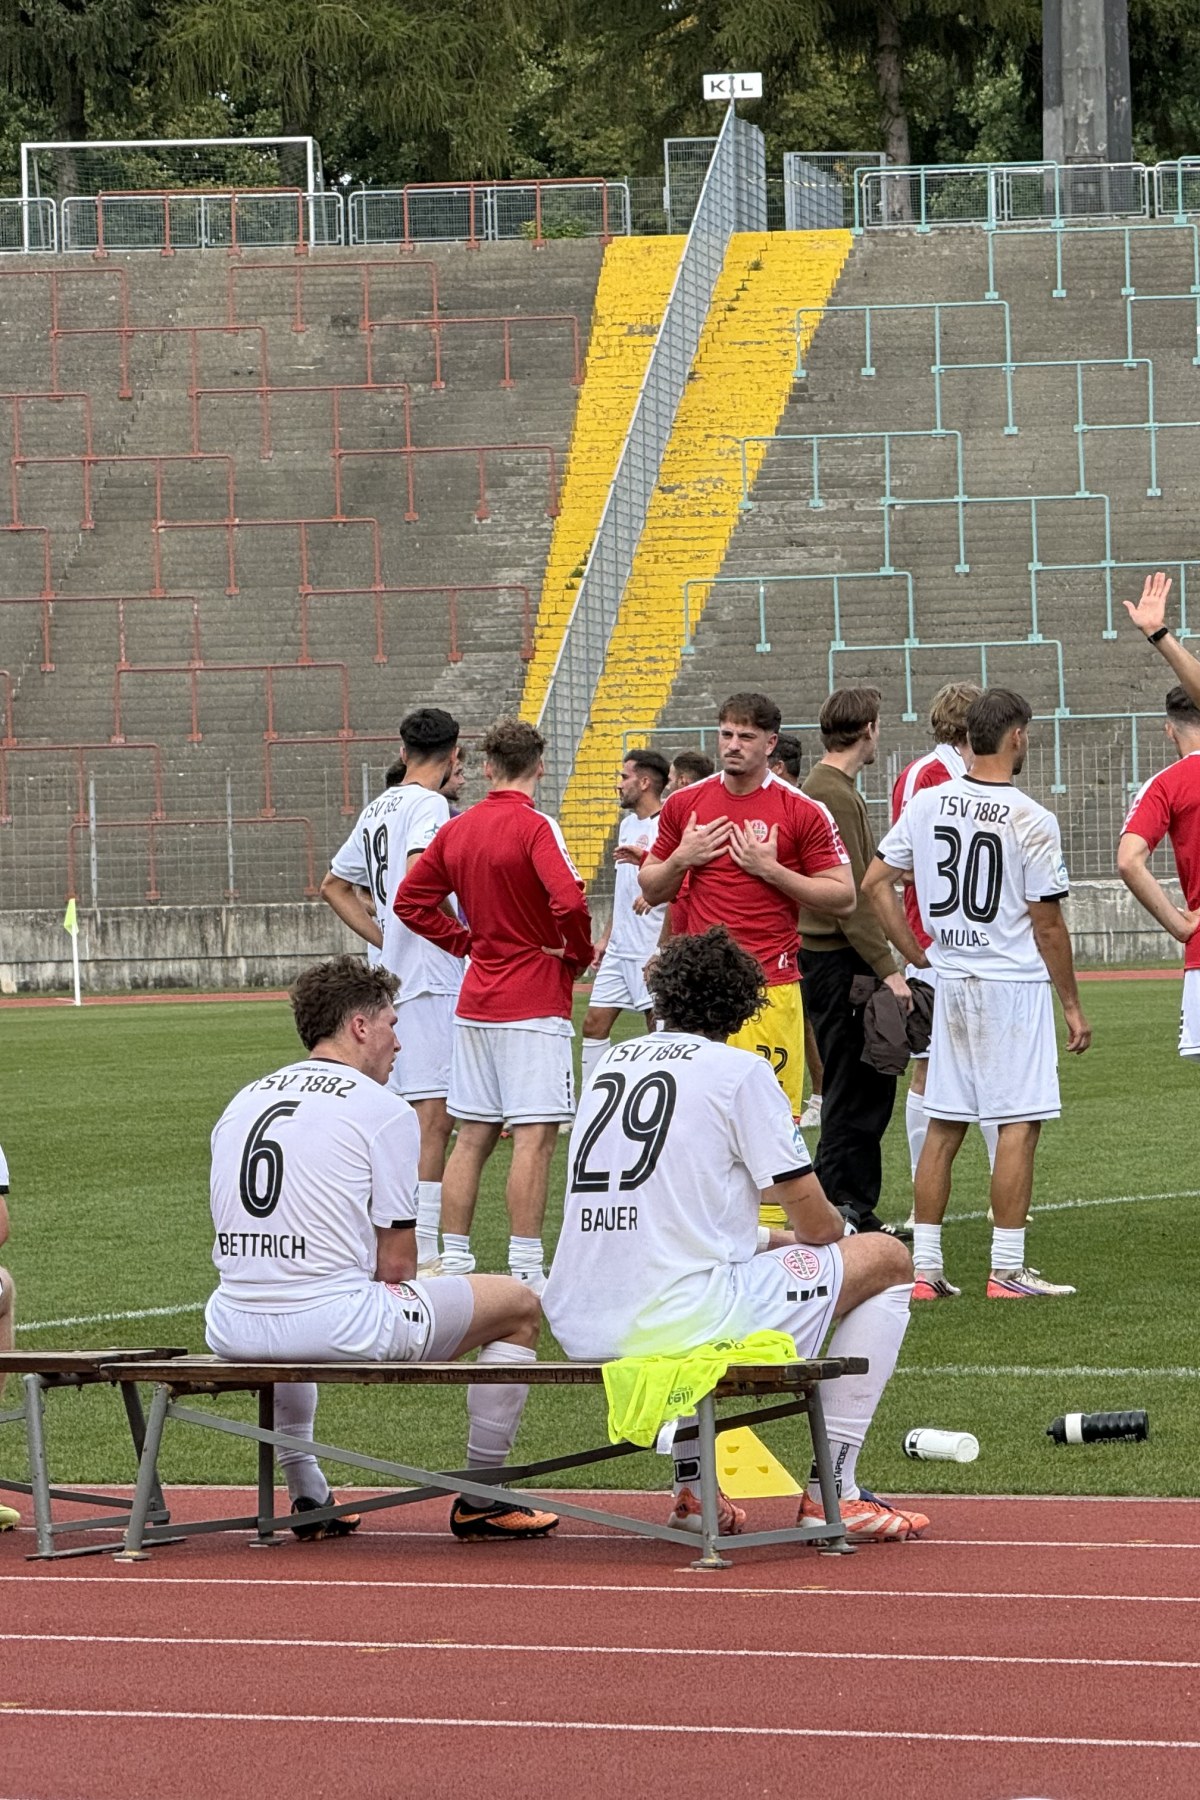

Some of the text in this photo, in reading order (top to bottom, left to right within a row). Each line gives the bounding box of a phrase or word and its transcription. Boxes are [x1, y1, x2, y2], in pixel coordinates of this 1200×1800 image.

[711, 79, 753, 93] K L
[940, 795, 1010, 825] TSV 1882
[363, 823, 388, 906] 18
[929, 825, 1003, 924] 30
[941, 929, 990, 947] MULAS
[606, 1043, 702, 1065] TSV 1882
[250, 1073, 357, 1099] TSV 1882
[570, 1070, 677, 1194] 29
[239, 1100, 302, 1219] 6
[581, 1206, 638, 1232] BAUER
[218, 1232, 306, 1260] BETTRICH
